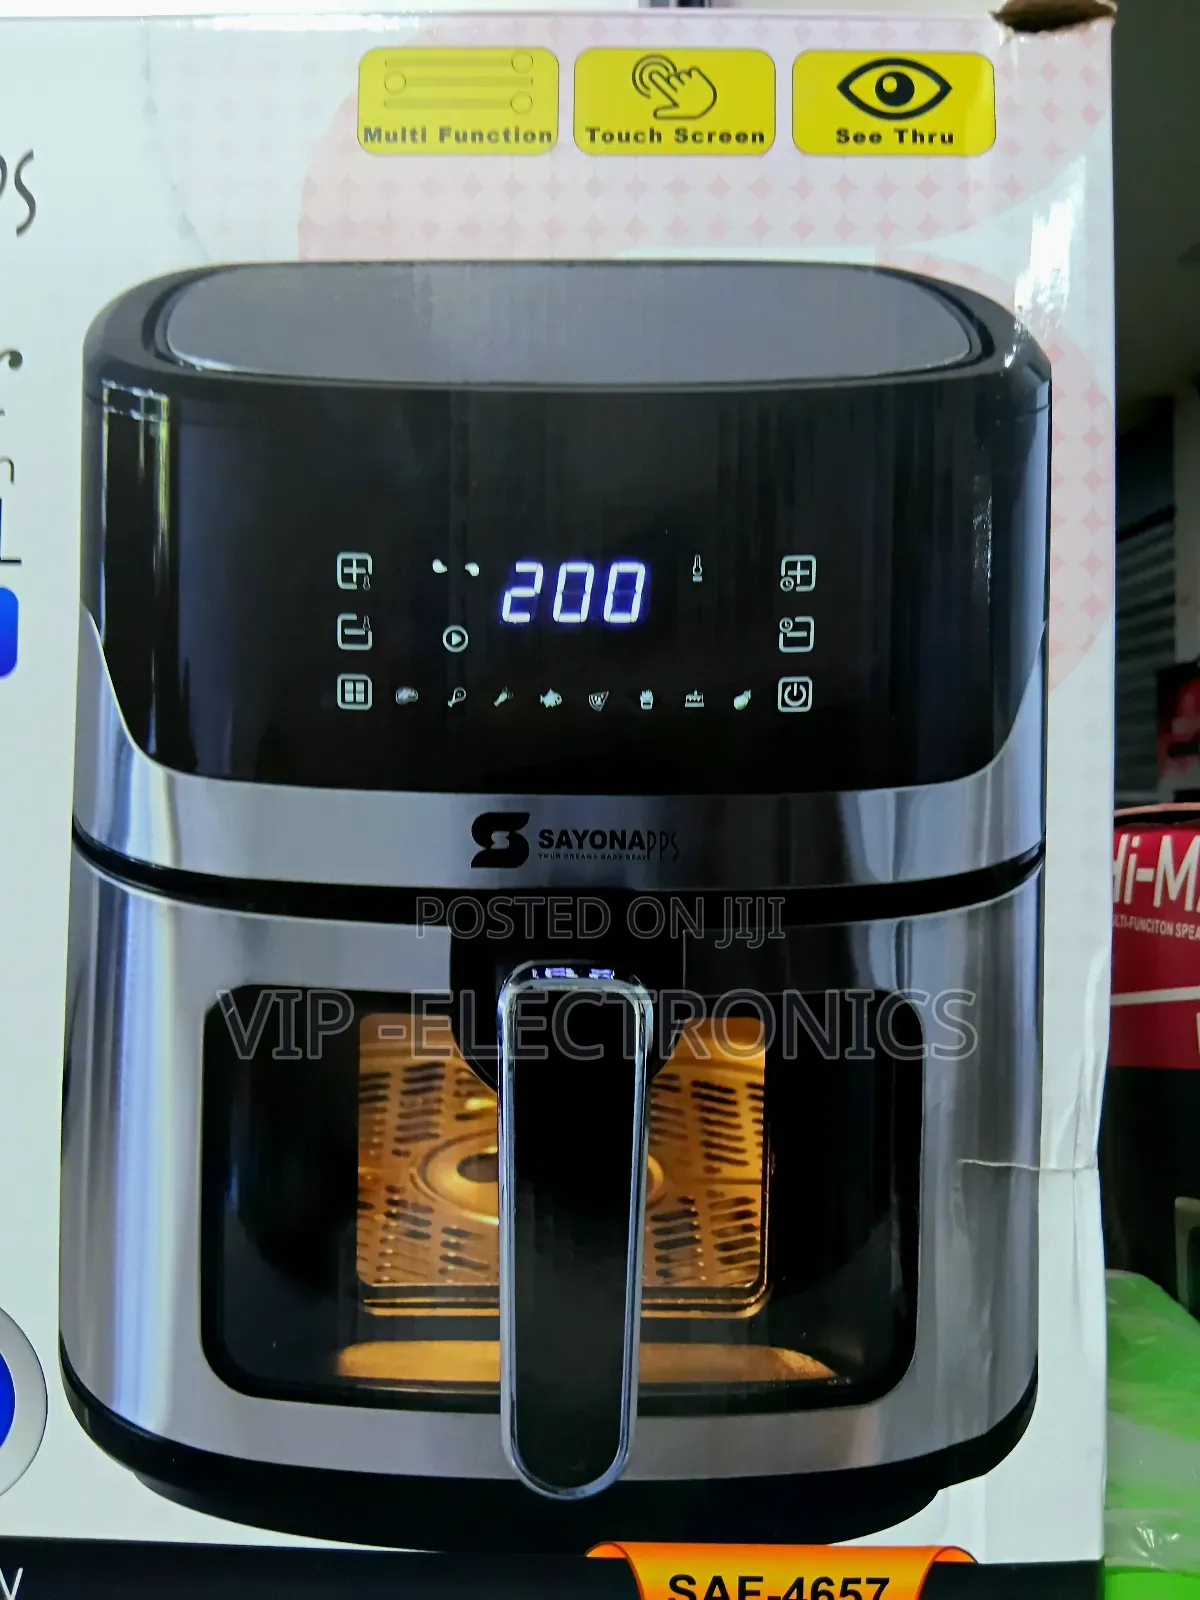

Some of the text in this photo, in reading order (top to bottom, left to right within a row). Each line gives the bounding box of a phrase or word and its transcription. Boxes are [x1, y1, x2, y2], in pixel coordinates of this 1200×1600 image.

[363, 126, 552, 144] Multi Function
[585, 127, 765, 145] Touch Screen
[836, 127, 955, 145] See Thru
[501, 561, 646, 624] 200
